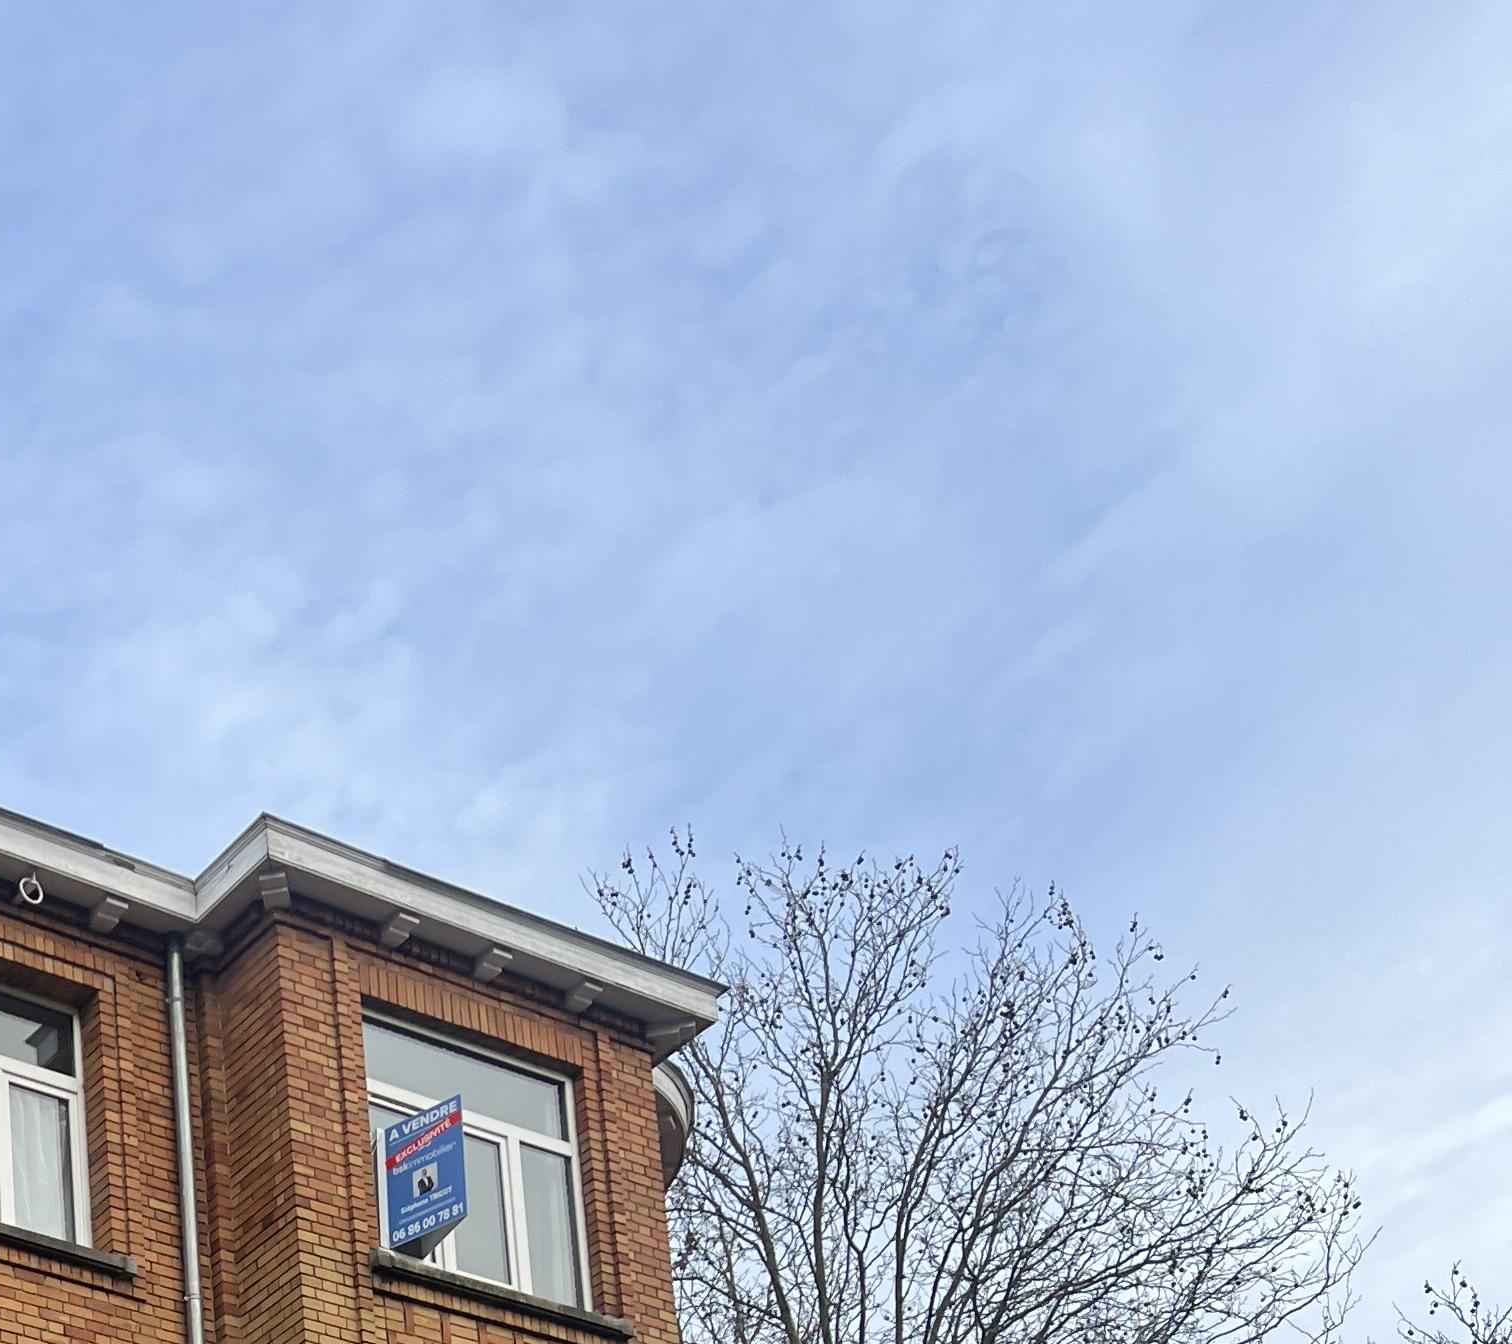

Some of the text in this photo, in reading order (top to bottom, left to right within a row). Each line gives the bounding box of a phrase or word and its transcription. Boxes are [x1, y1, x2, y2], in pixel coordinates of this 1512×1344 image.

[389, 1100, 458, 1142] A VENDRE
[392, 1228, 406, 1242] 06
[423, 1215, 436, 1229] 00
[451, 1202, 464, 1216] 81
